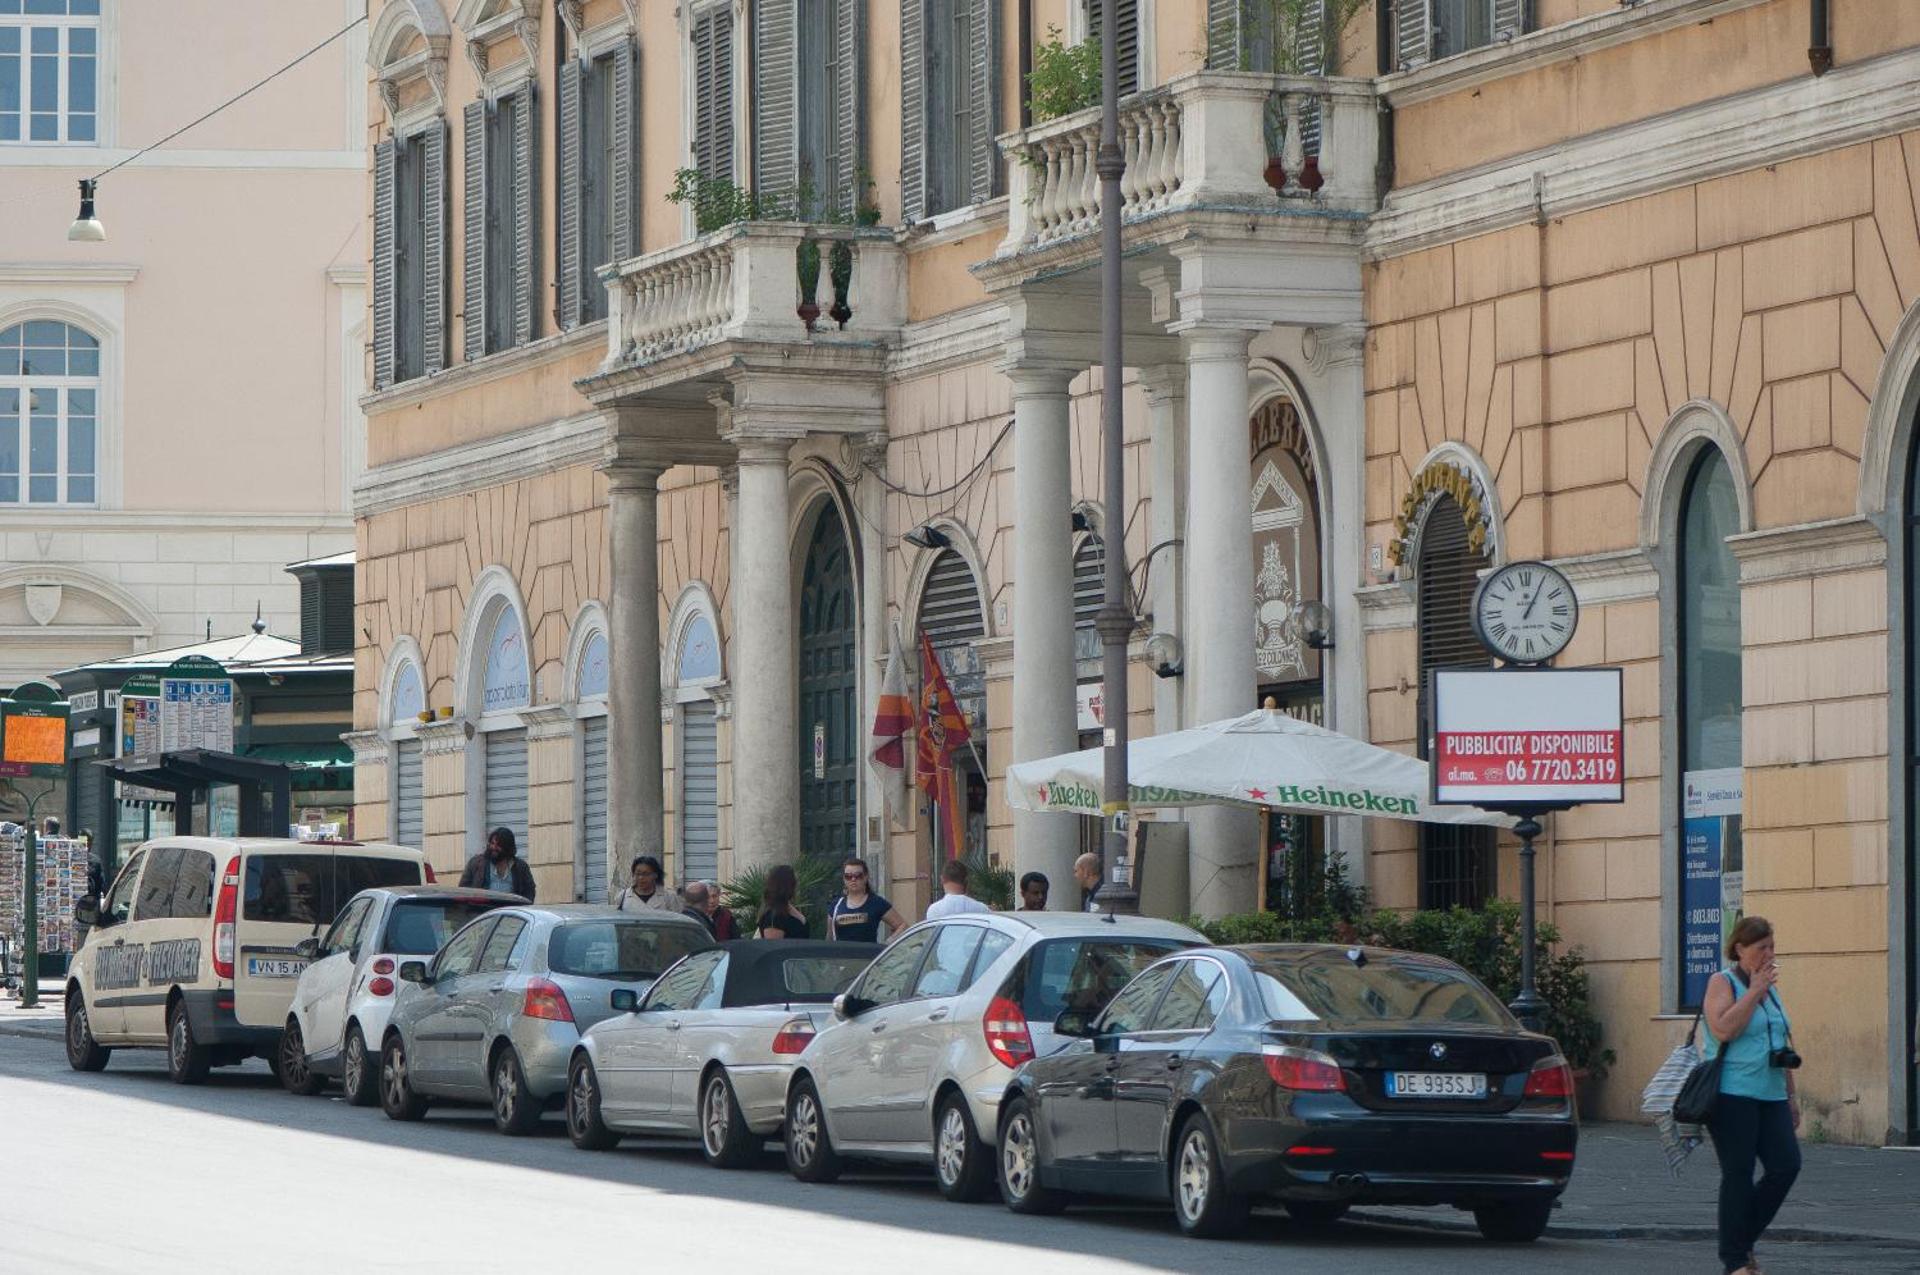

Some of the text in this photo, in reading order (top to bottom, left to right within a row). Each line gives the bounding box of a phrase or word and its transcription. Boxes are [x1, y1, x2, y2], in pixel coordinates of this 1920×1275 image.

[1446, 734, 1614, 756] PUBBLICITA' DISPONIBILE
[1506, 759, 1527, 781] 06
[1531, 758, 1617, 781] 7720.3419
[1278, 785, 1419, 815] Heineken
[257, 962, 274, 974] VN
[278, 962, 289, 974] 15
[1397, 1075, 1476, 1094] DE 993SJ
